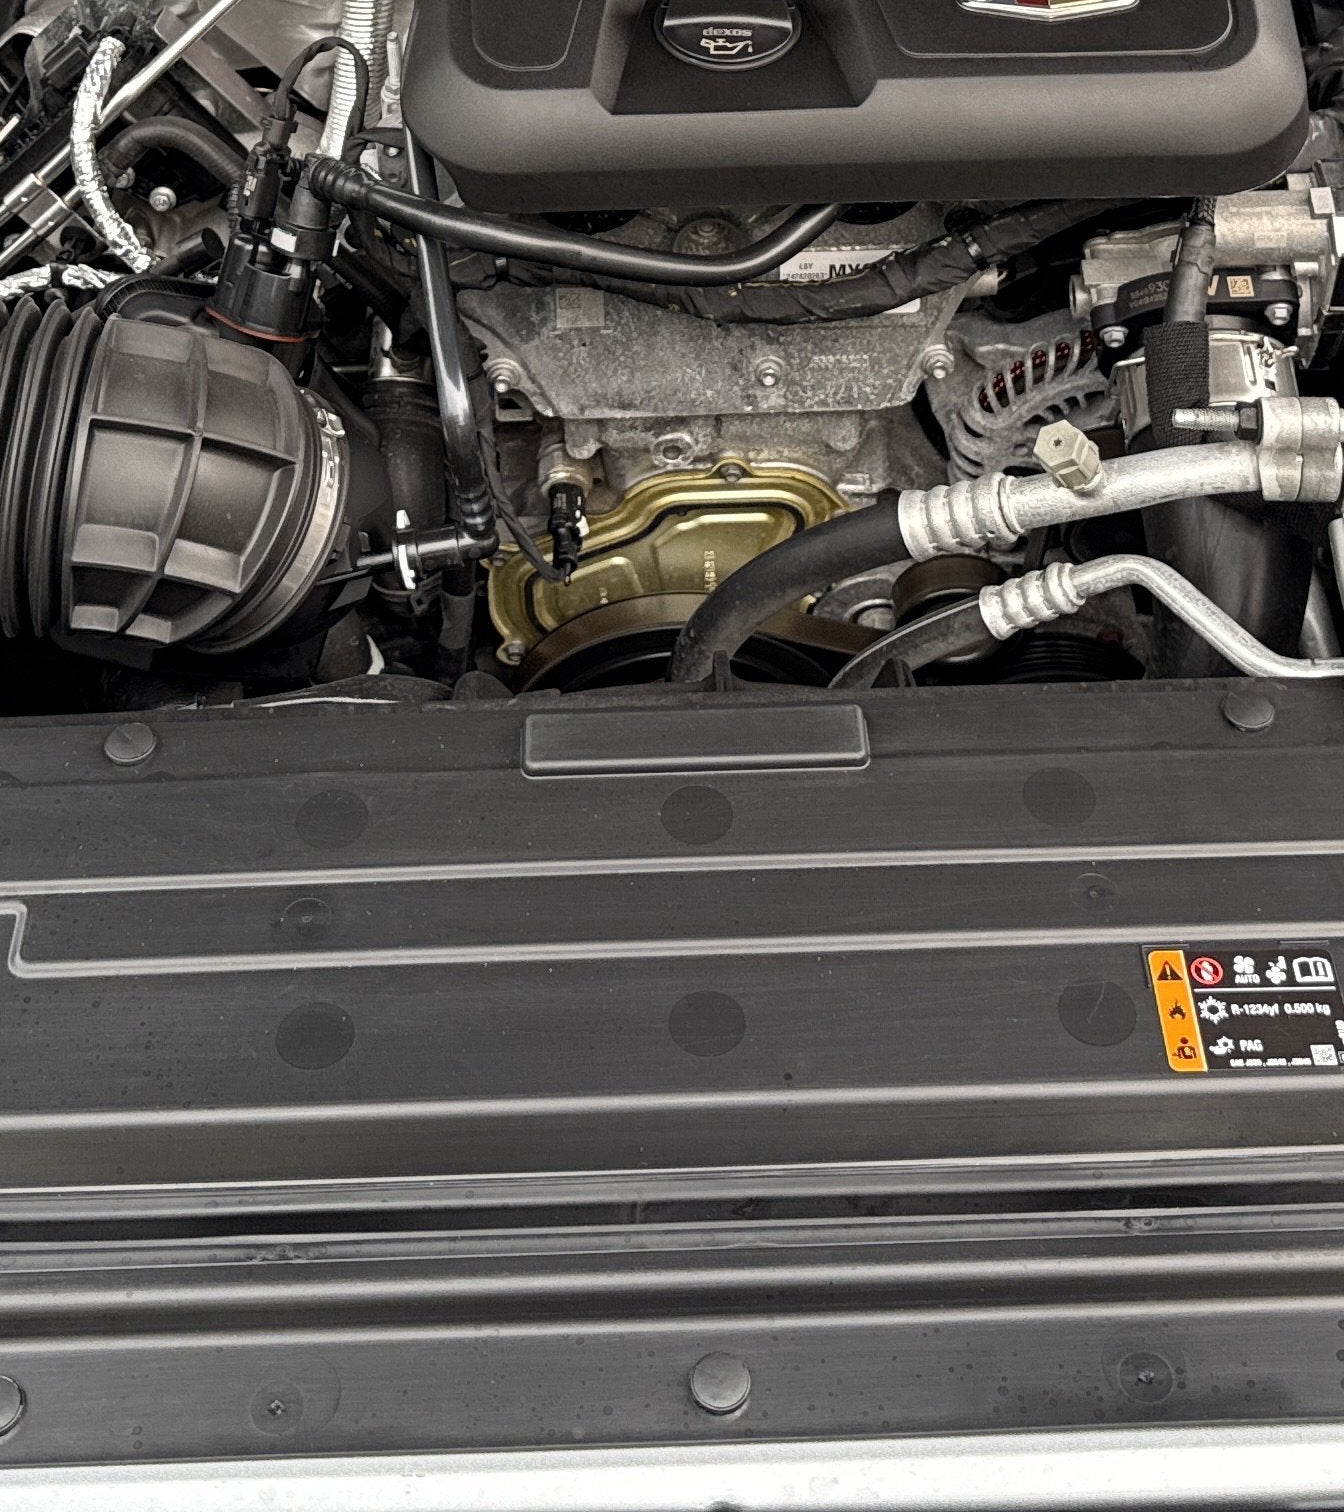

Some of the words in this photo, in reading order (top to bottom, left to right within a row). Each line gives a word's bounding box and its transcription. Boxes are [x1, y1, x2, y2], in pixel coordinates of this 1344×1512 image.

[702, 26, 753, 37] dexos
[1234, 974, 1261, 984] AUTO
[1284, 1002, 1315, 1016] 0.500
[1316, 1001, 1331, 1017] kg
[1239, 1039, 1264, 1052] PAG
